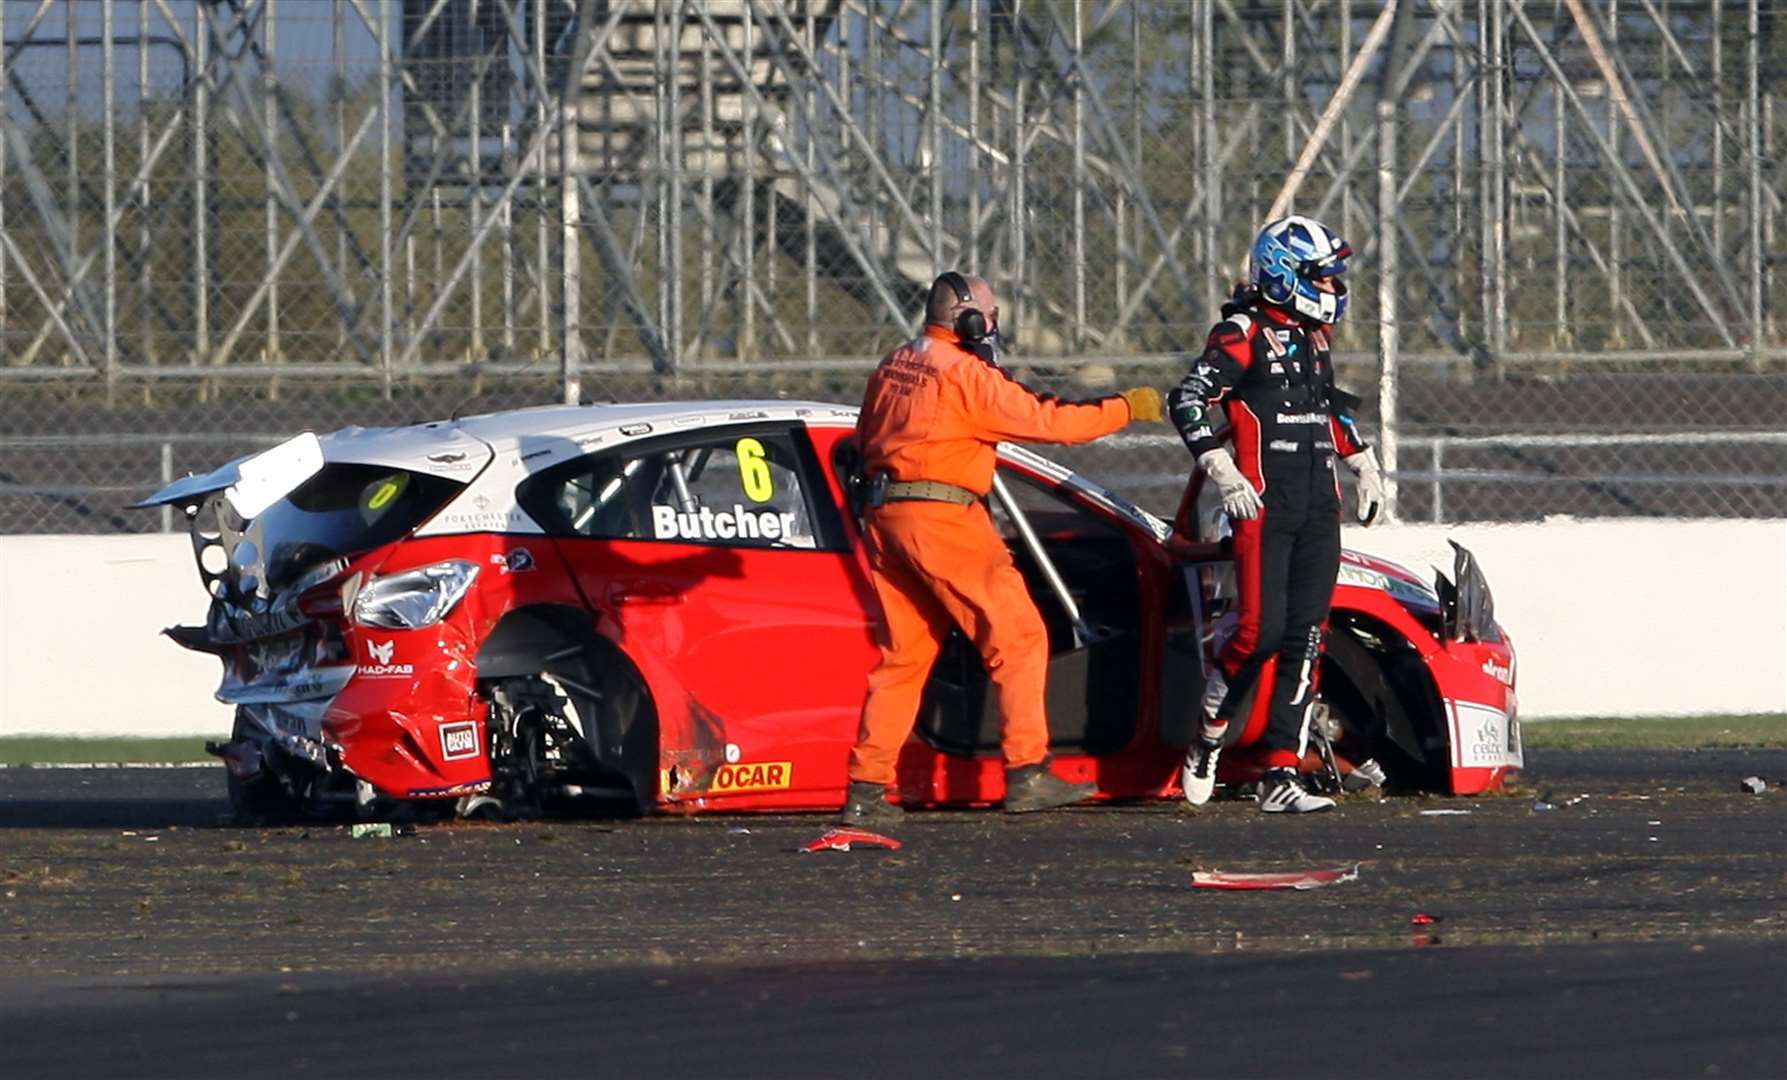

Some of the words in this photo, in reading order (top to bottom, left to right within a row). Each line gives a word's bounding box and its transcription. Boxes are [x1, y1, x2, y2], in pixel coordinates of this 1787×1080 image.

[736, 438, 773, 503] 6
[652, 504, 795, 539] Butcher
[358, 664, 414, 675] HAD-FAB
